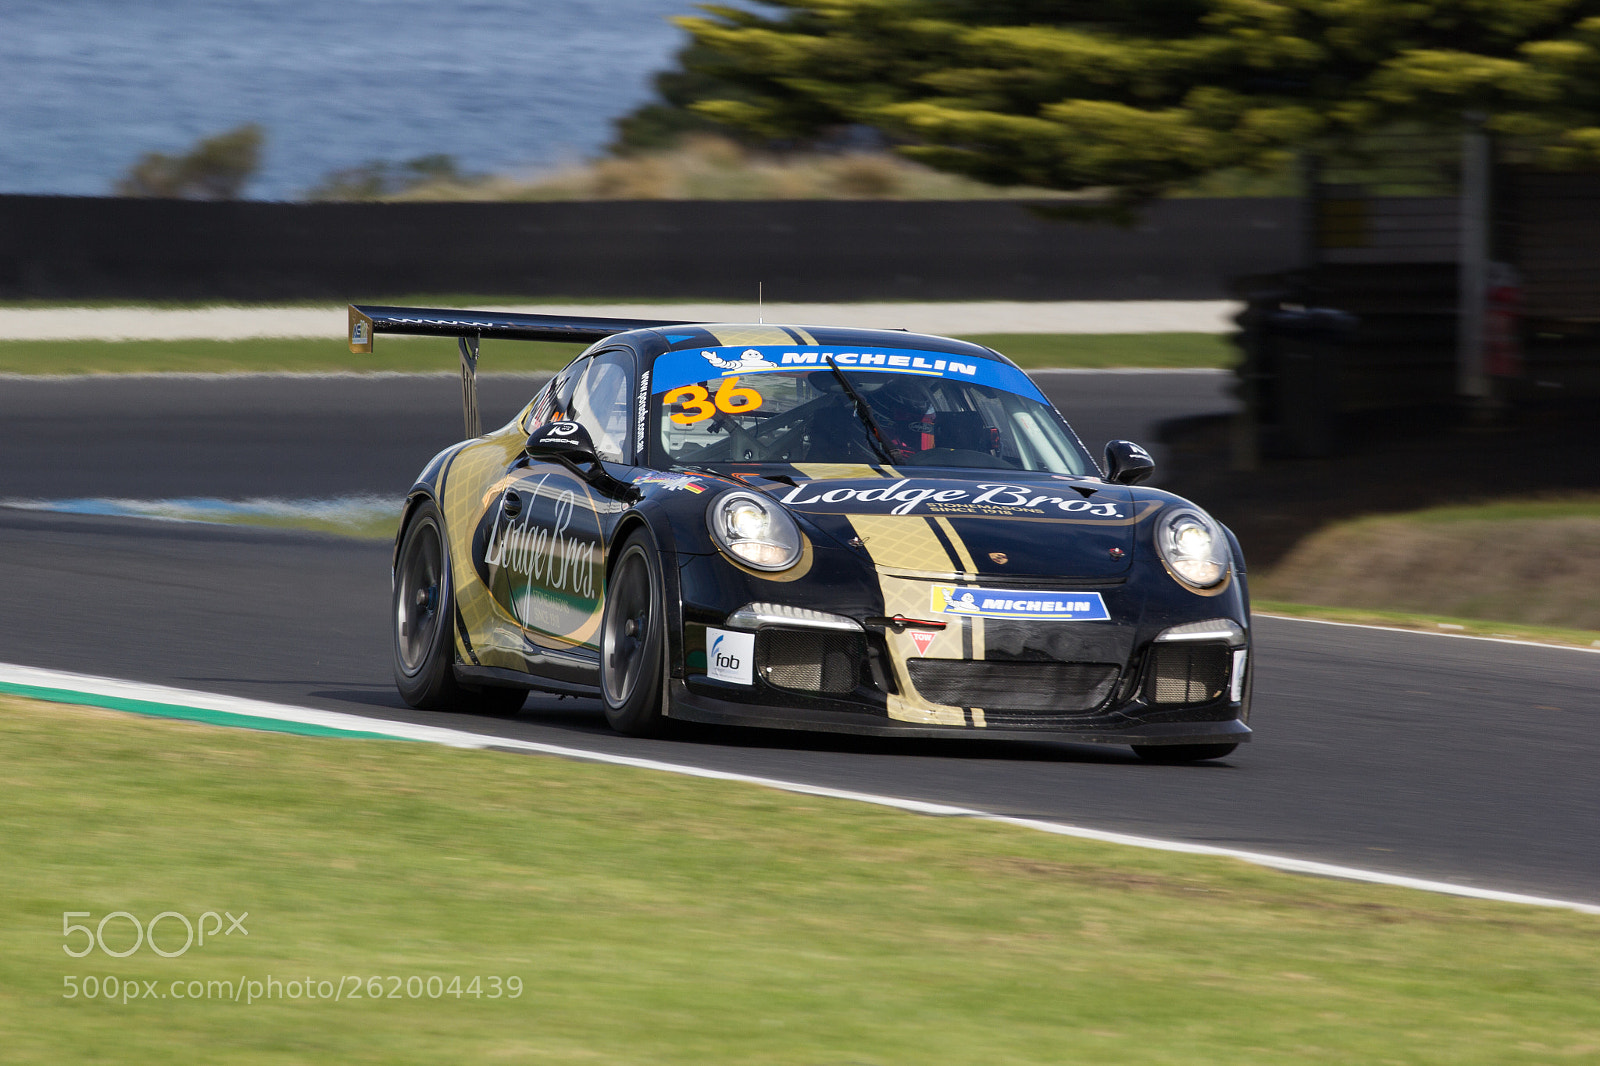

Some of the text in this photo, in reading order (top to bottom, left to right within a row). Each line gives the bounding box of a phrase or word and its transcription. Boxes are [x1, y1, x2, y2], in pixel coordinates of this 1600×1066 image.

[781, 352, 977, 376] MICHELIN
[663, 376, 763, 425] 36
[780, 478, 1125, 518] Lodge Bros.
[926, 502, 1045, 514] STONEMASONS
[484, 473, 596, 629] Lodge Bros.
[981, 598, 1091, 612] MICHELIN
[913, 632, 933, 642] TOW
[716, 652, 740, 670] fob
